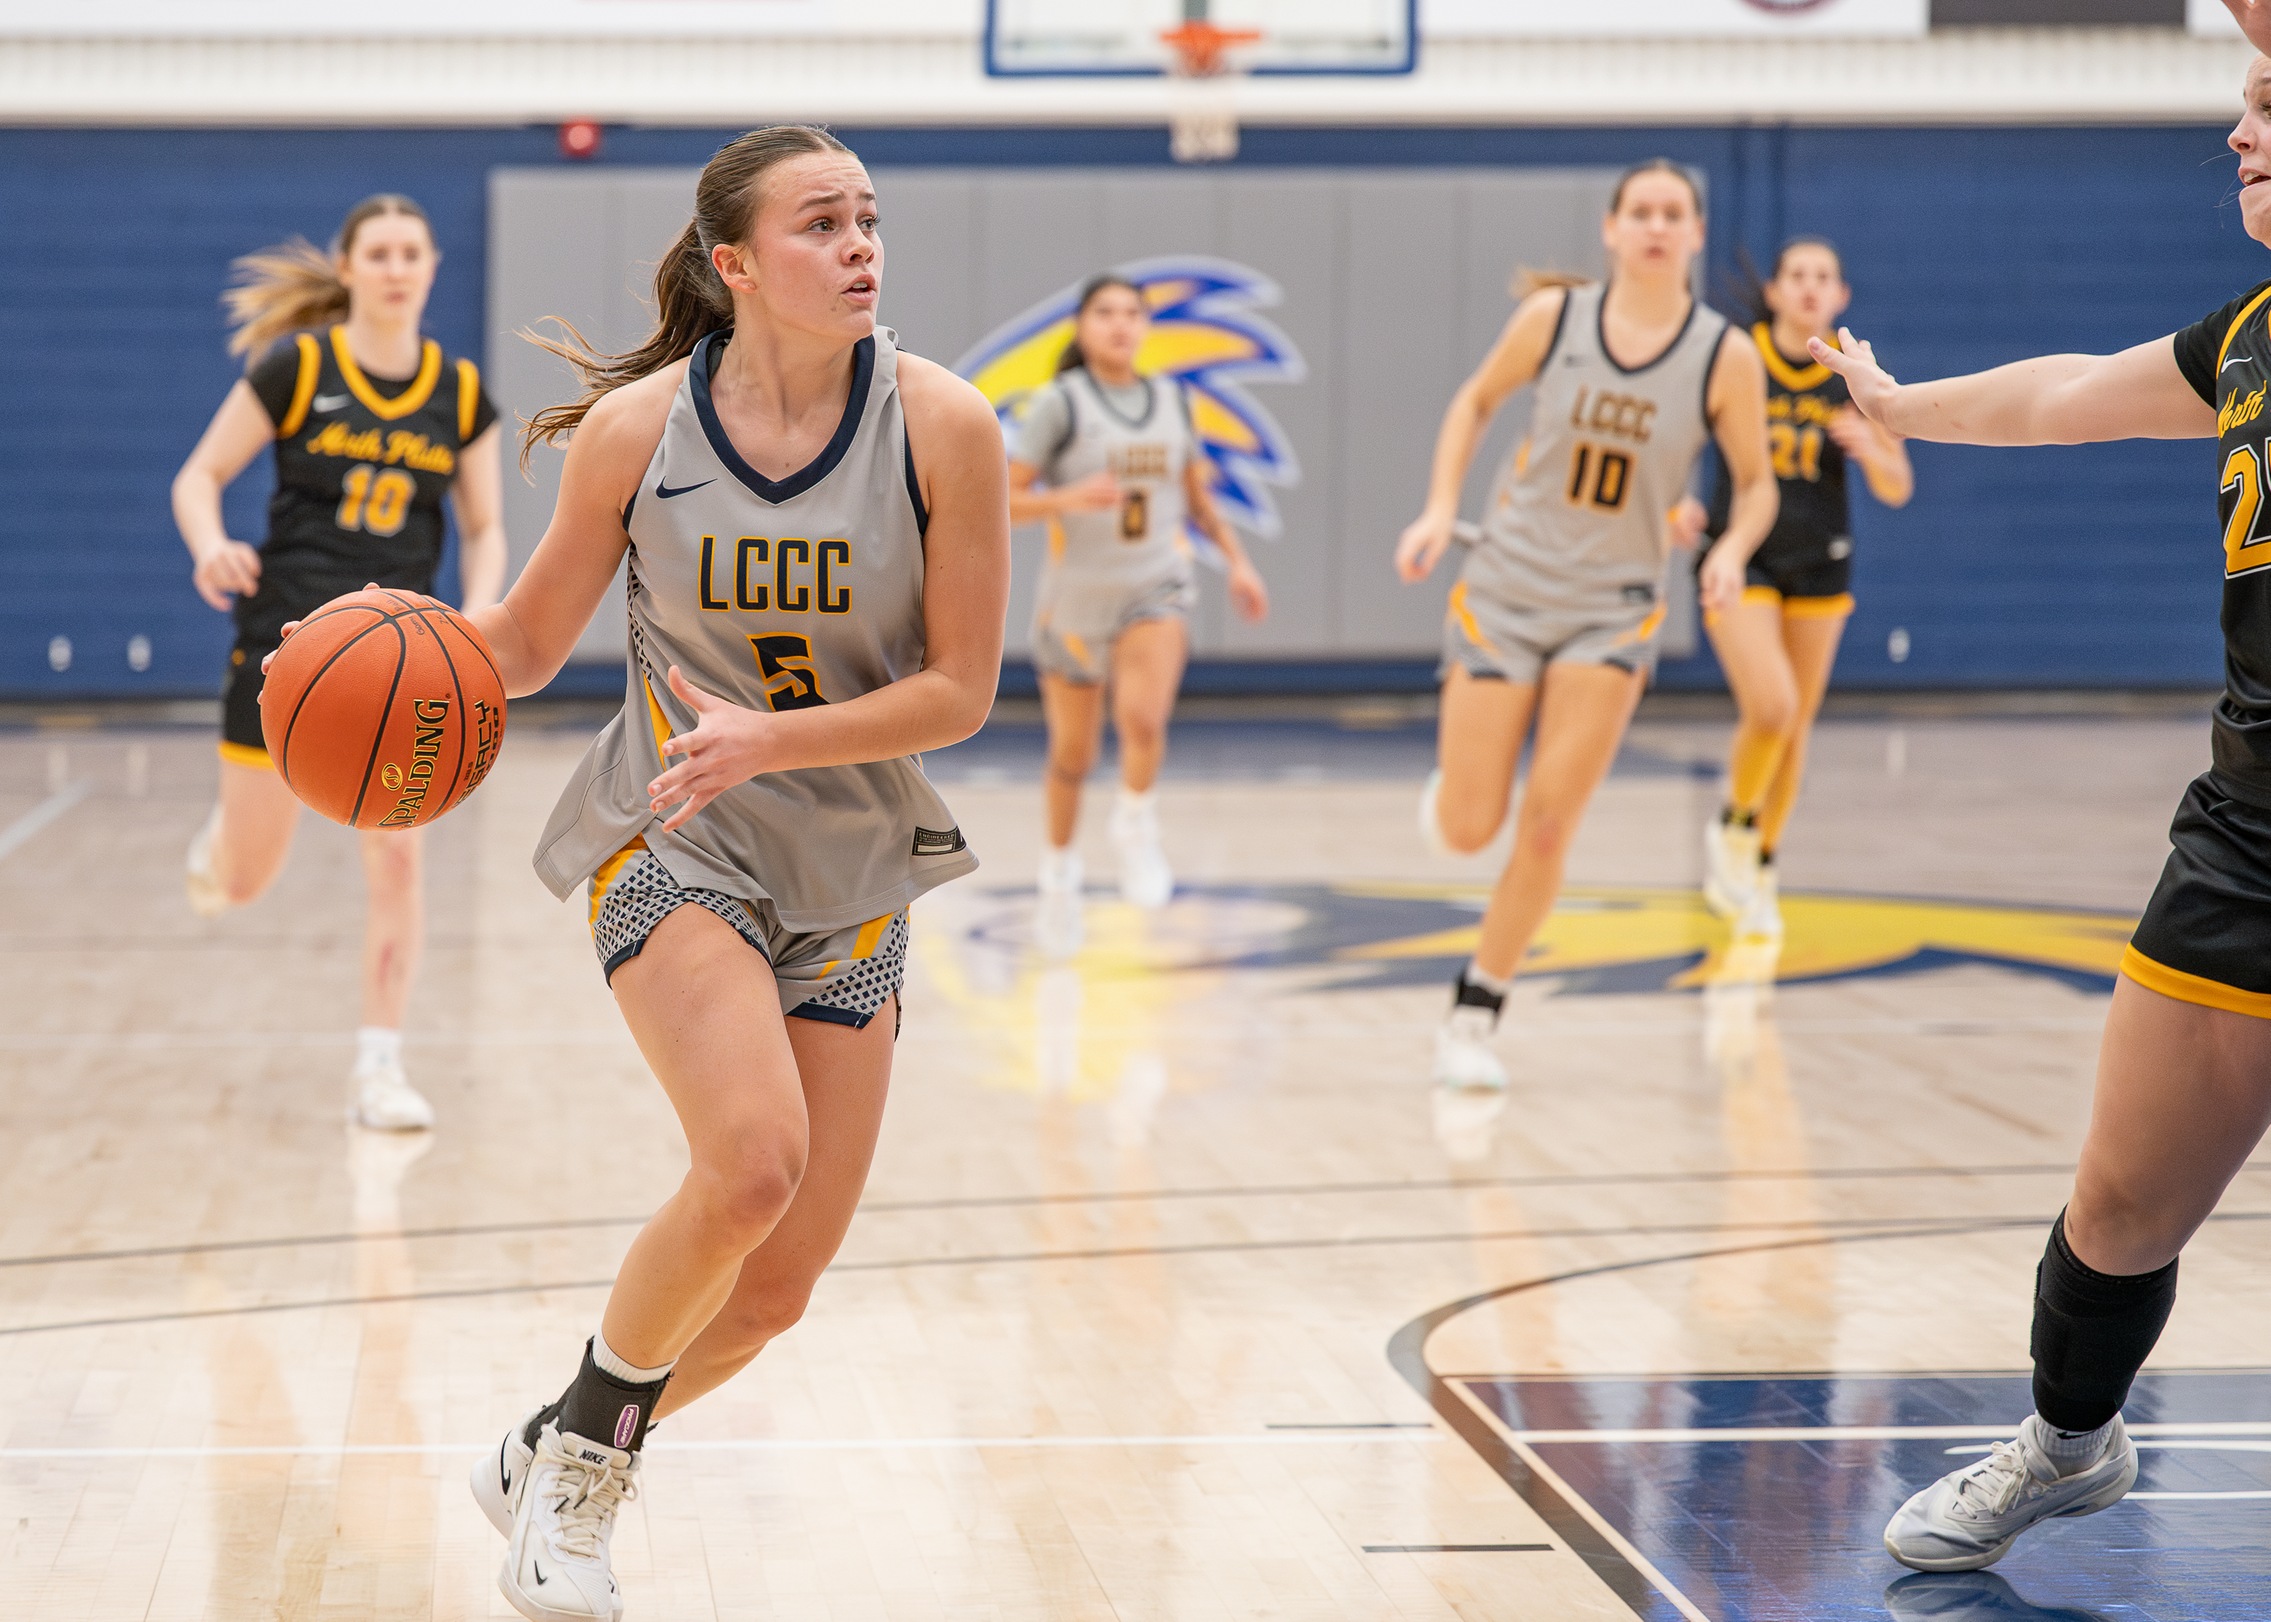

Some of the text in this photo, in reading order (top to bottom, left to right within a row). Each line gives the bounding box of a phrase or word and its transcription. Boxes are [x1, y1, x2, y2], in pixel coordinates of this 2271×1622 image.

[335, 463, 417, 538] 10
[1565, 441, 1638, 517] 10
[2220, 436, 2271, 580] 2
[698, 535, 853, 615] LCCC
[745, 631, 832, 713] 5
[376, 698, 450, 830] SPALDING
[579, 1449, 607, 1465] NIKE
